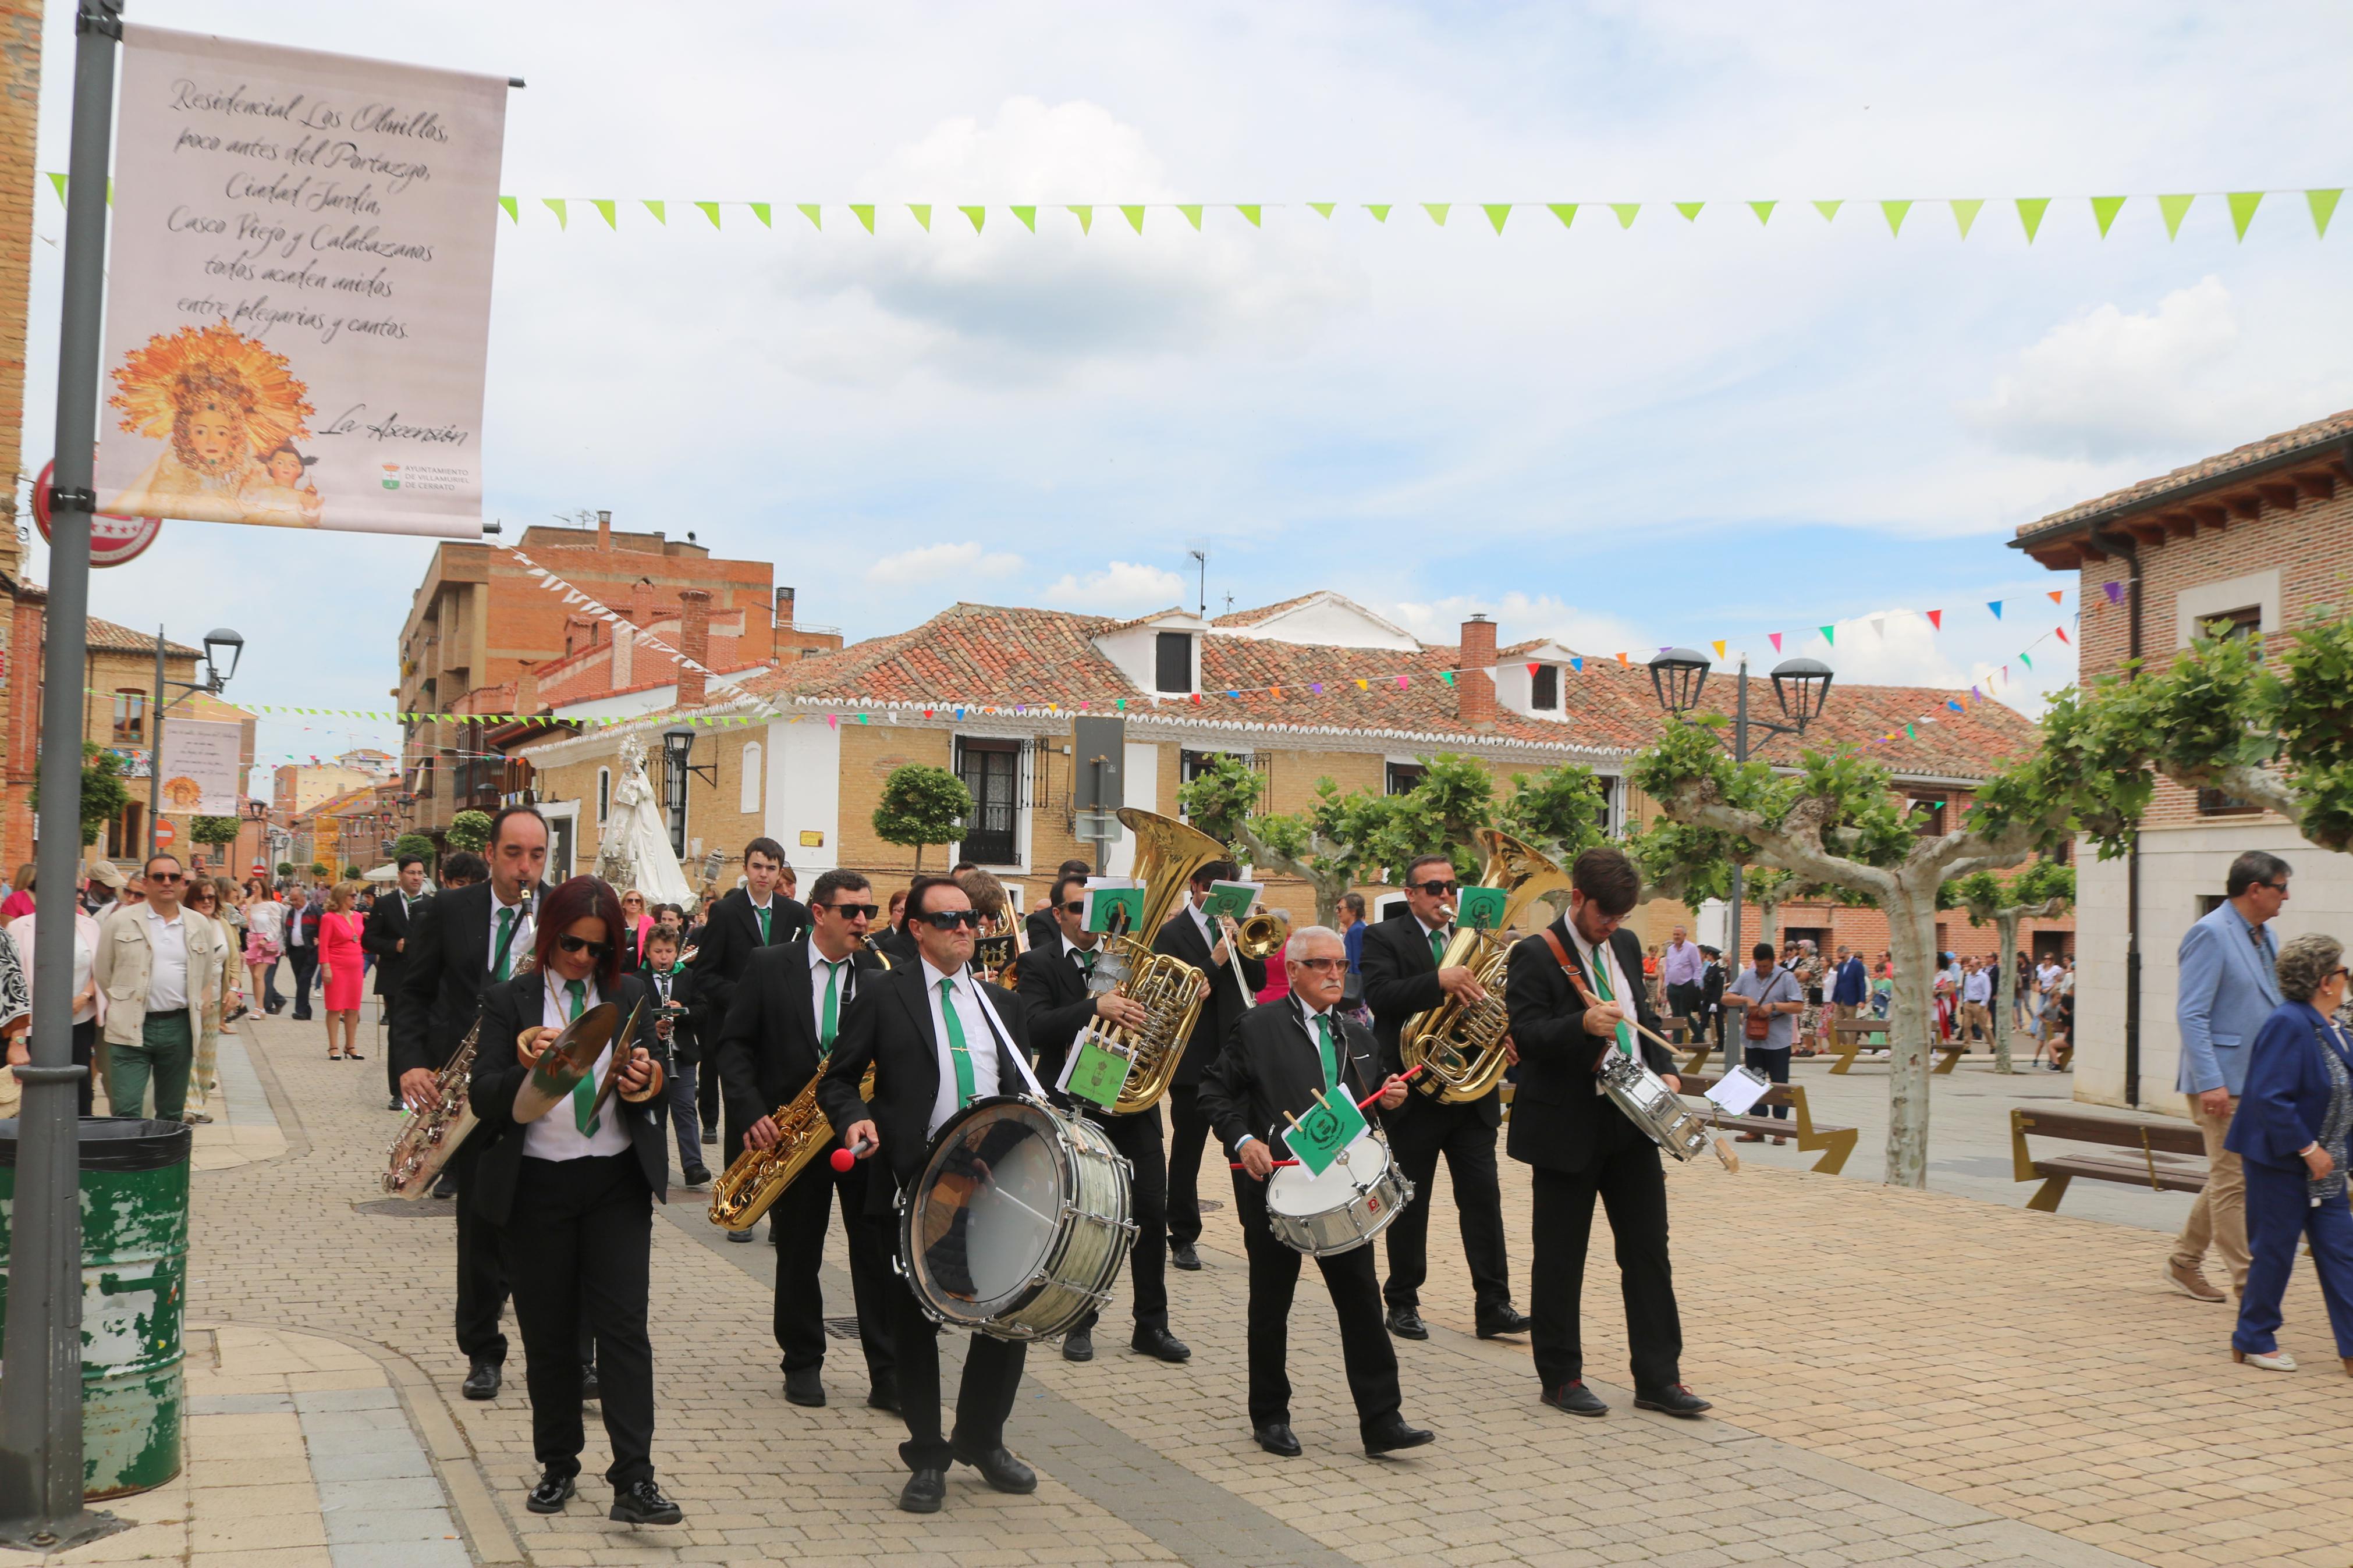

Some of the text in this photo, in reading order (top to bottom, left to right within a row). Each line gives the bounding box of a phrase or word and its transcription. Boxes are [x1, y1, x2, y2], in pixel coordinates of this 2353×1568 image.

[169, 79, 303, 120] Residencial
[299, 100, 341, 130] Los
[173, 127, 220, 153] poco
[226, 136, 278, 161] antes
[285, 134, 327, 165] del
[225, 170, 310, 205] Ciudad
[168, 205, 434, 262] Casco Viejo y Calabazanos
[204, 249, 393, 298] todos acuden unidos
[176, 294, 229, 319] entre
[233, 295, 326, 337] plegarias
[321, 318, 343, 345] y
[318, 403, 468, 446] La Ascensión
[404, 465, 469, 476] AYUNTAMIENTO
[417, 474, 470, 484] VILLAMURIEL
[418, 482, 456, 490] CERRATO
